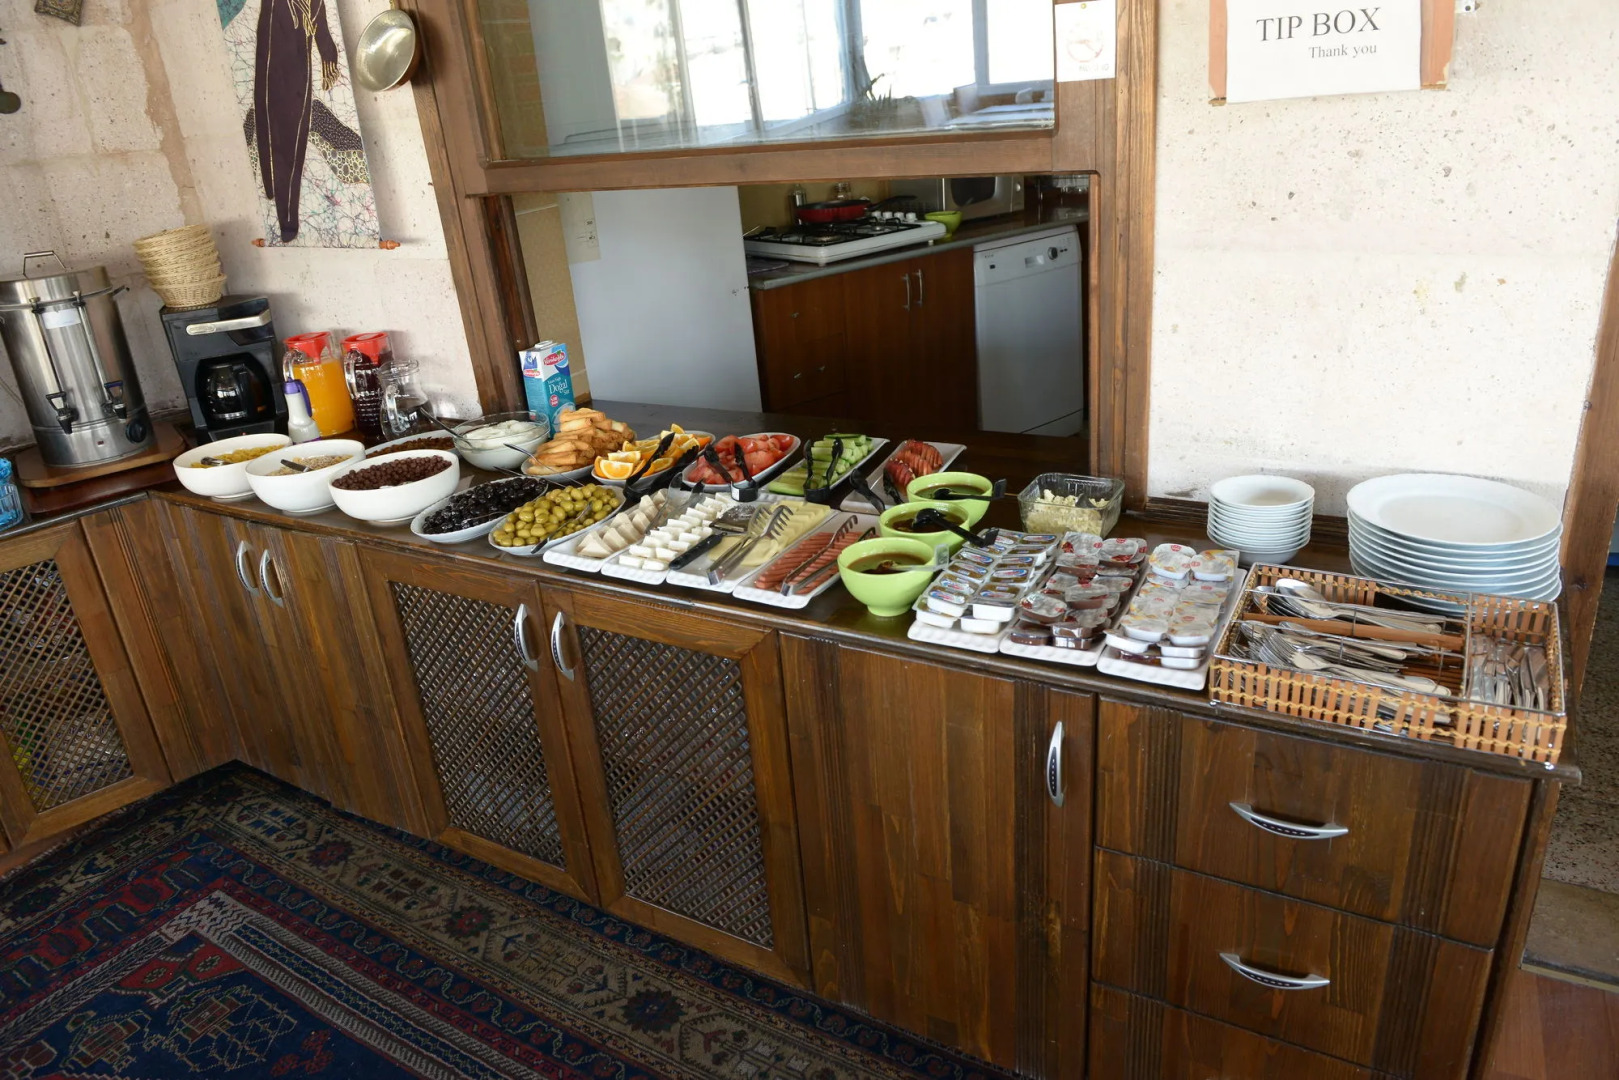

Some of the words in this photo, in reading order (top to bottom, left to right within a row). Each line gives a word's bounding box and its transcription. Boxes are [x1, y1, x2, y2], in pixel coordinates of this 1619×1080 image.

[1256, 15, 1303, 42] TIP
[1312, 7, 1381, 37] BOX
[1308, 44, 1348, 59] Thank
[1353, 44, 1377, 58] you
